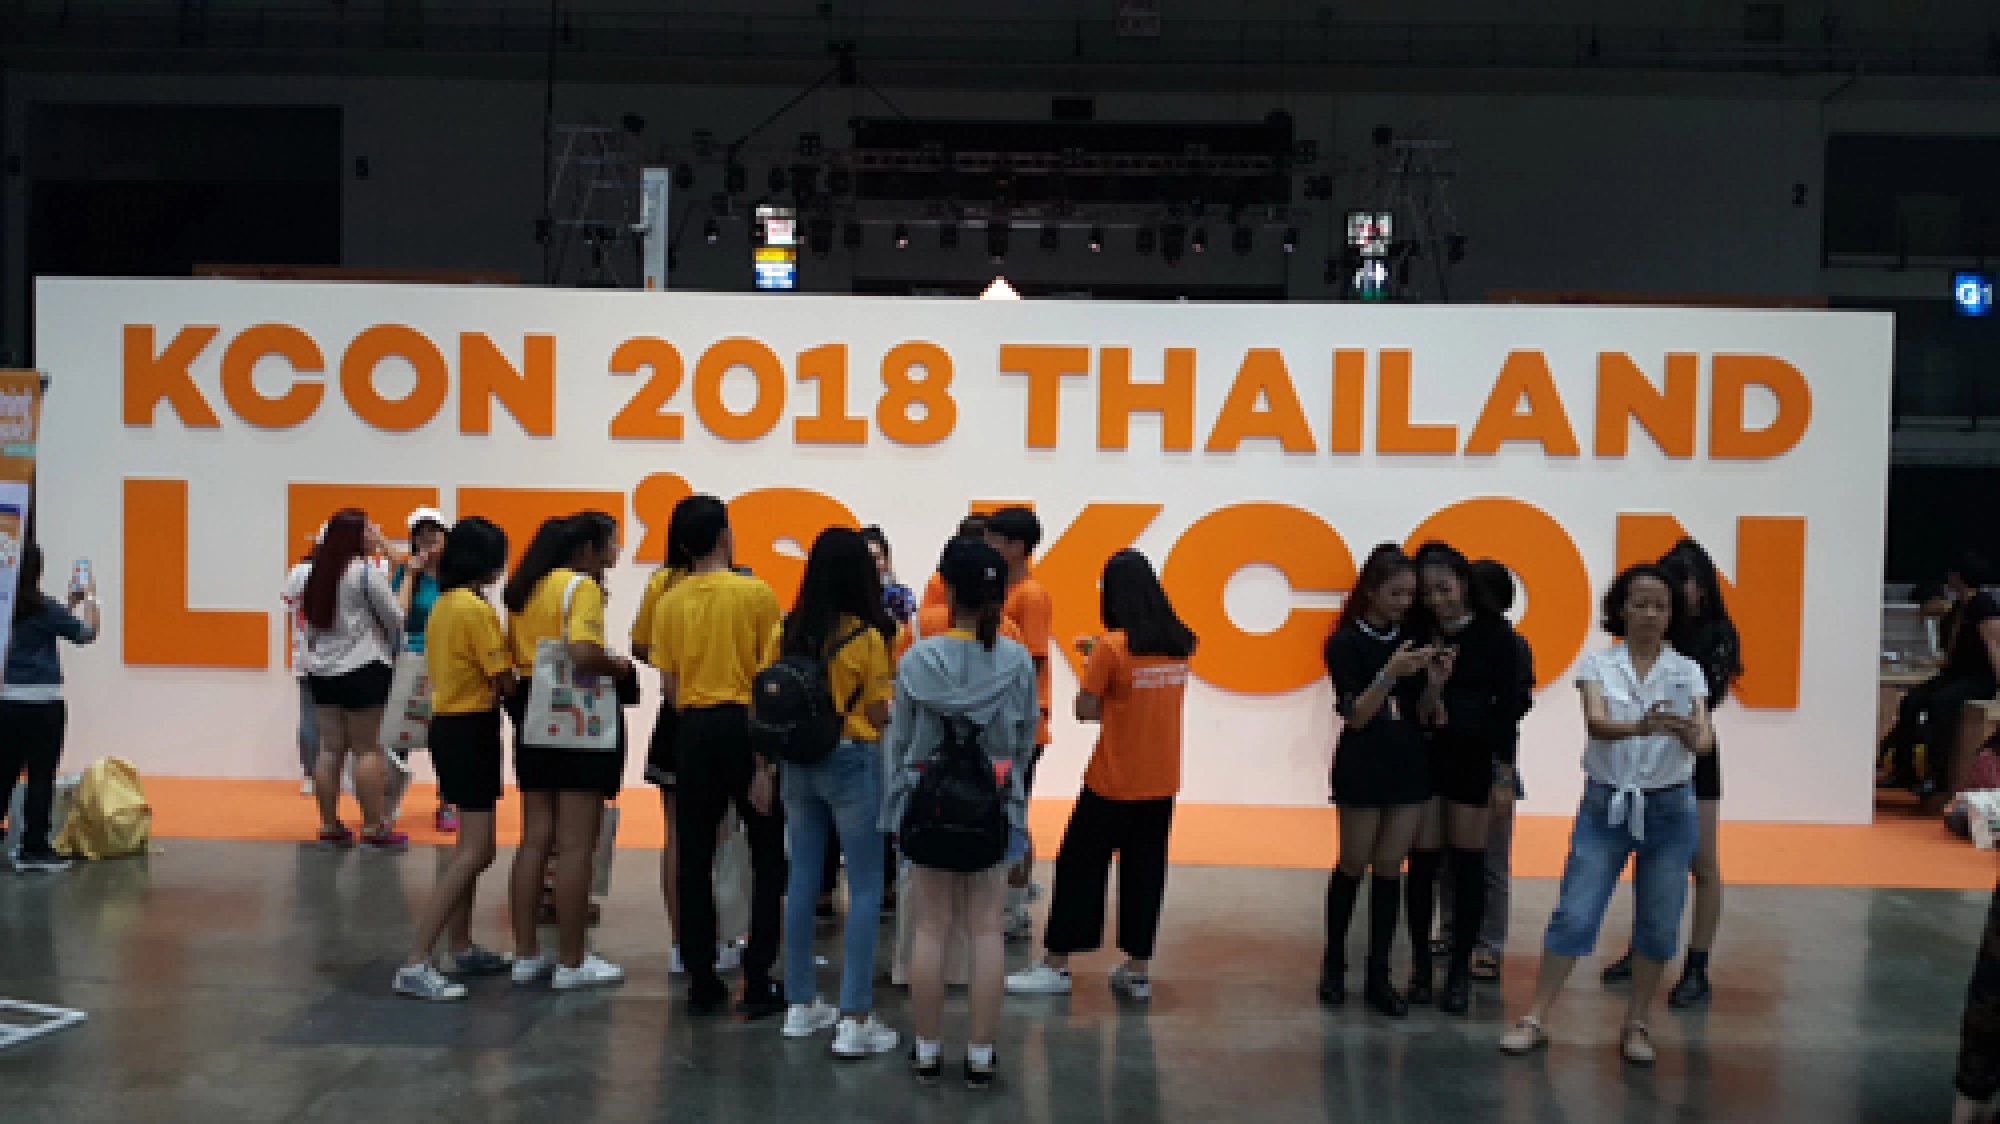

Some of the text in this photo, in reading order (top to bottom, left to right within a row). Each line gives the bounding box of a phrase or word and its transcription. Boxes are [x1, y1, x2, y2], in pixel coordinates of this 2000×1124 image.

[122, 322, 556, 434] KCON
[608, 336, 957, 445] 2018
[1000, 342, 1811, 459] THAILAND
[122, 472, 862, 669] L'S
